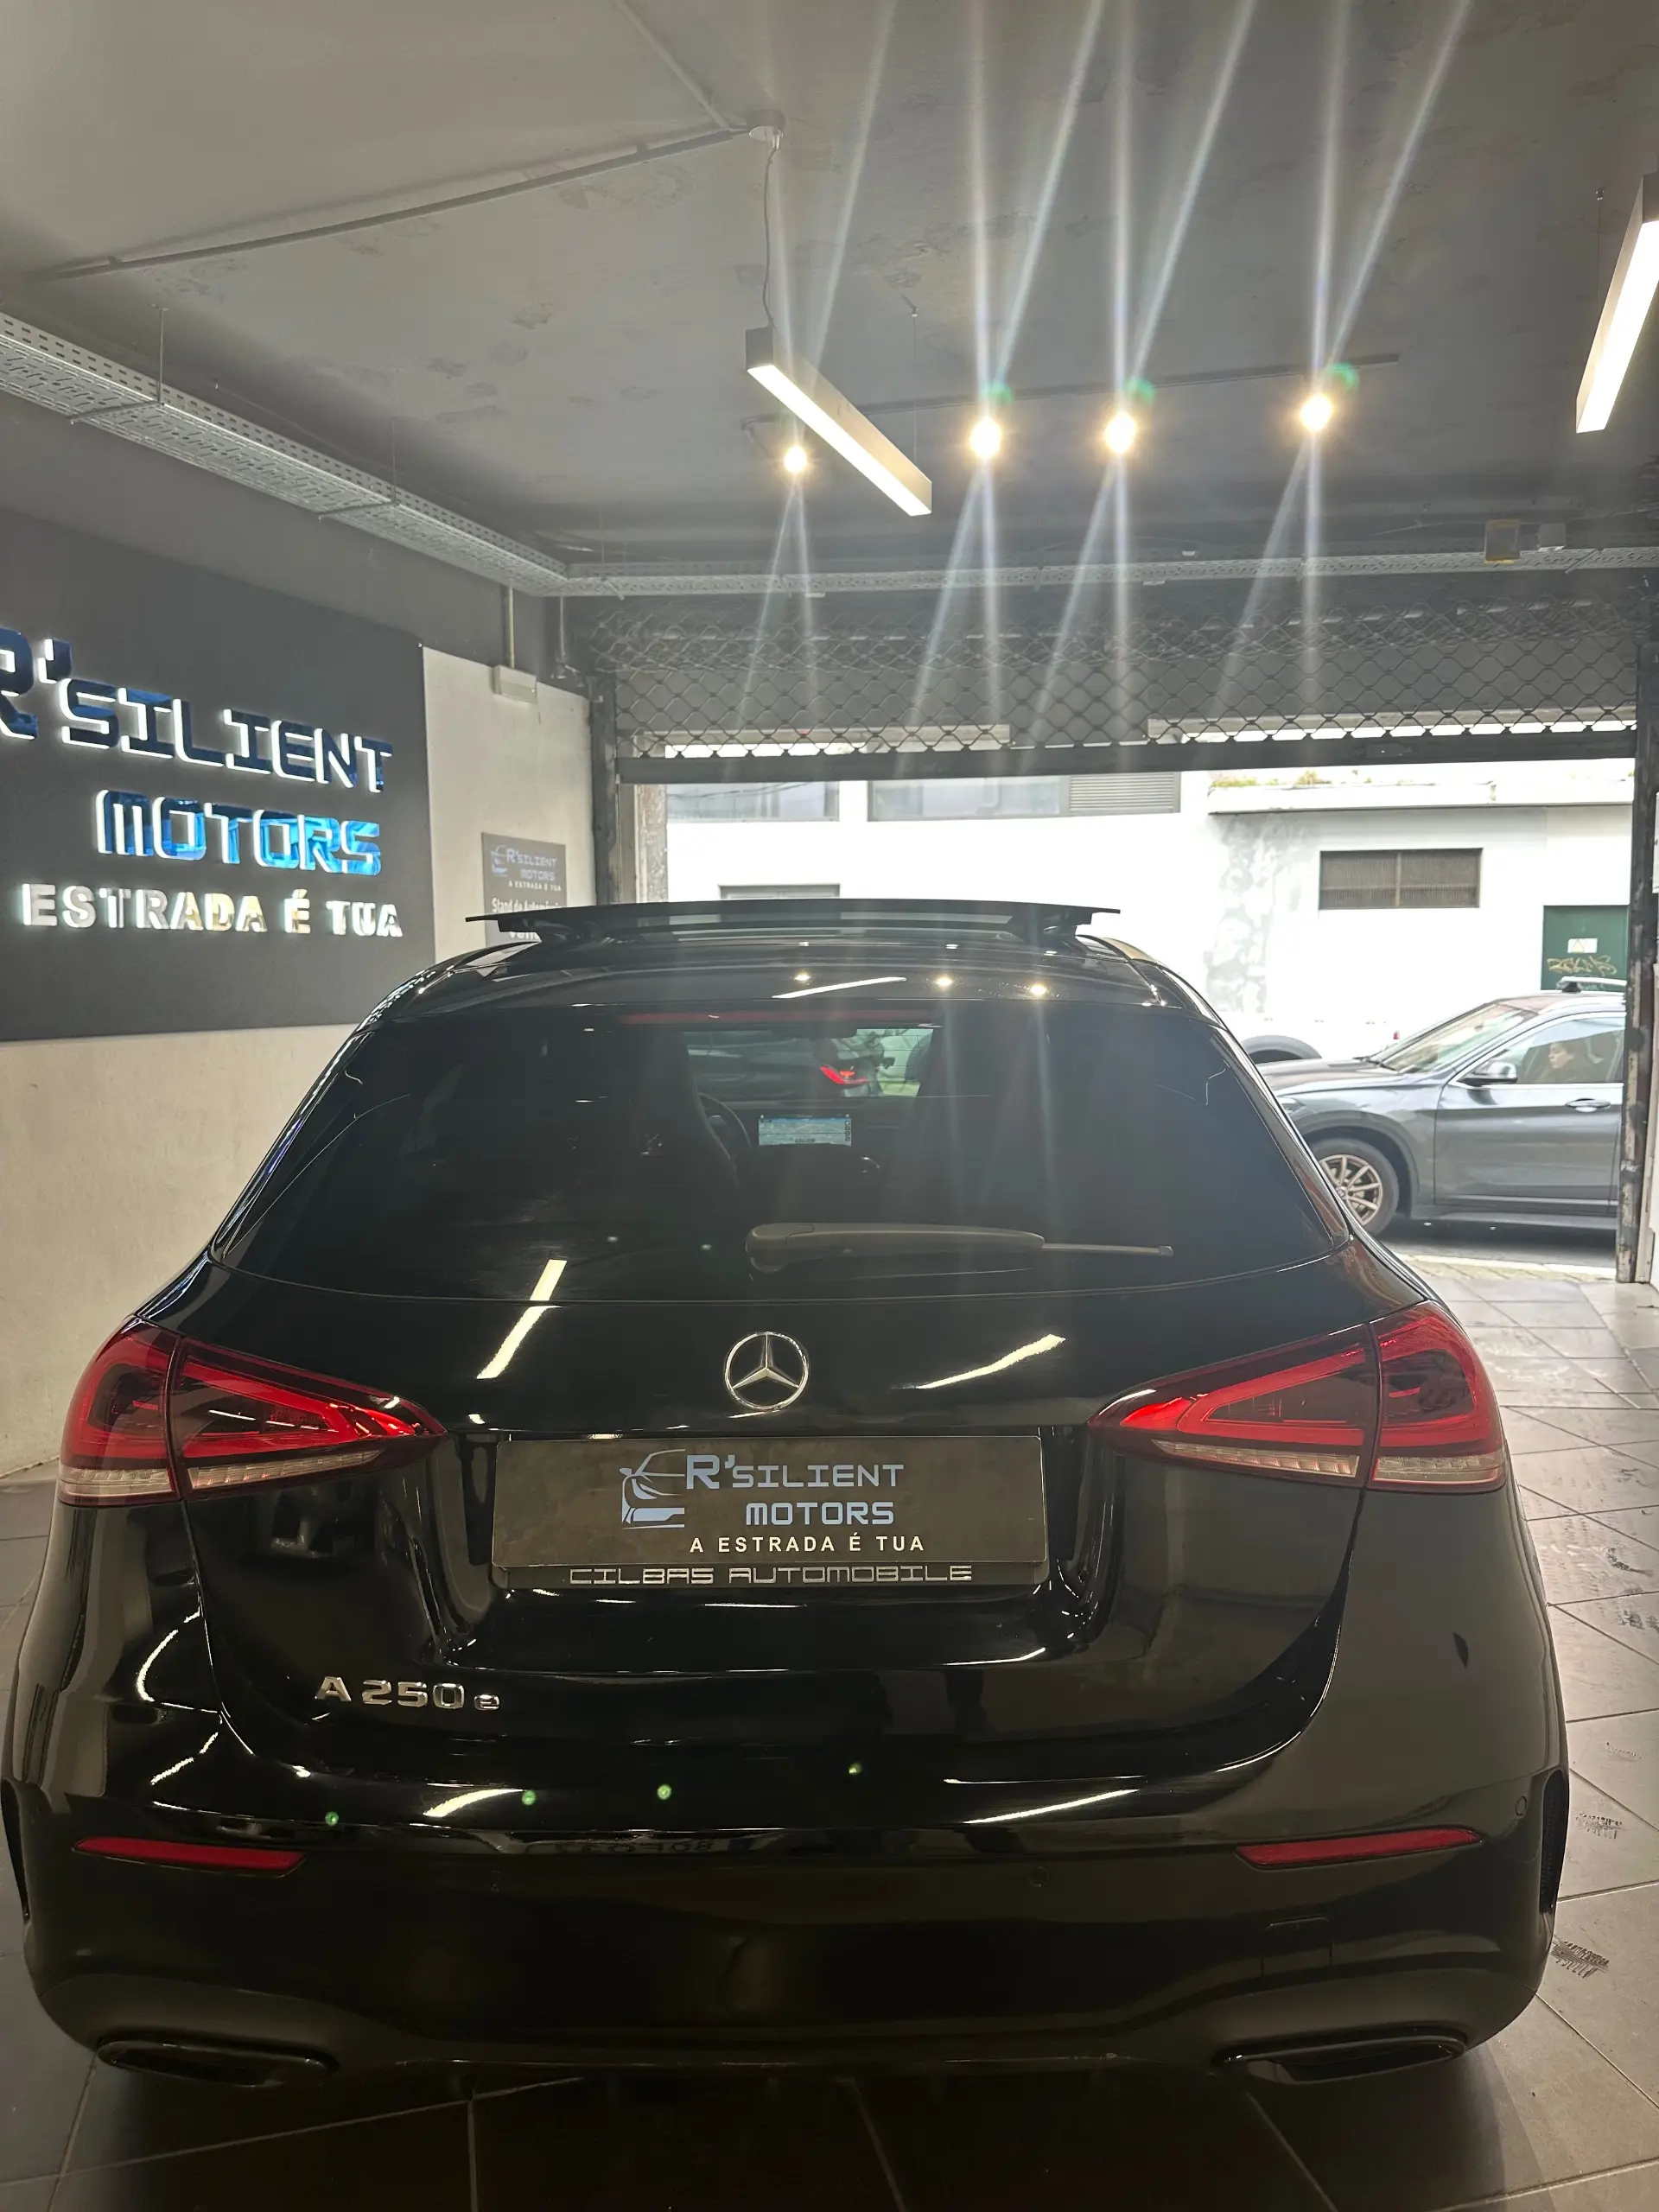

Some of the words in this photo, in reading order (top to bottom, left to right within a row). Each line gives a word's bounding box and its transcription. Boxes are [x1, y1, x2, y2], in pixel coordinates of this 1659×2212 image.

[96, 789, 381, 875] MOTORS
[21, 882, 268, 933] ESTRADA
[283, 888, 311, 935] É
[326, 899, 404, 938] TUA
[686, 1454, 904, 1490] R'SILIENT
[746, 1502, 894, 1525] MOTORS
[690, 1537, 704, 1553] A
[718, 1535, 835, 1553] ESTRADA
[849, 1532, 861, 1552] É
[875, 1535, 924, 1552] TUA
[569, 1567, 714, 1585] CILBAS
[728, 1565, 973, 1585] AUTOMOBILE
[315, 1676, 352, 1702] A
[361, 1679, 465, 1710] 250
[474, 1693, 500, 1711] e
